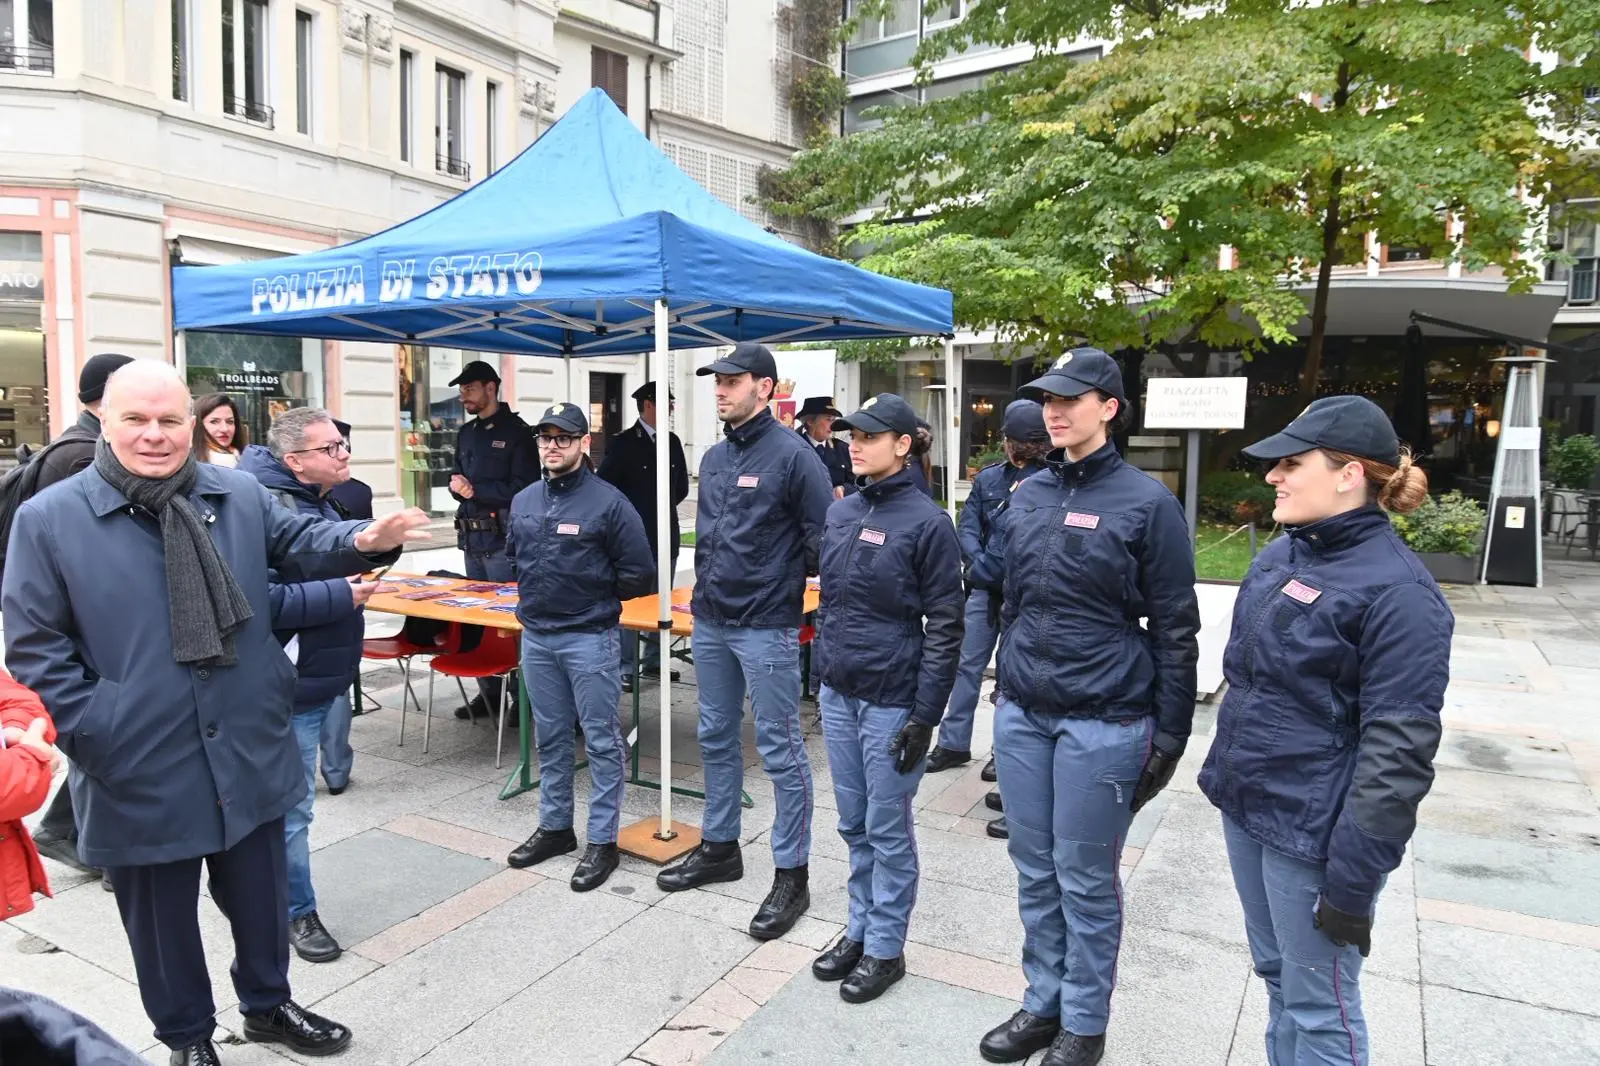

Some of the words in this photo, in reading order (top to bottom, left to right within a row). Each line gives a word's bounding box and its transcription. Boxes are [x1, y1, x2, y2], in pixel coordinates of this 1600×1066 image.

[251, 265, 365, 315] POLIZIA
[379, 259, 415, 302] DI
[426, 251, 543, 299] STATO
[217, 373, 279, 385] TROLLBEADS
[1163, 386, 1229, 396] PIAZZETTA
